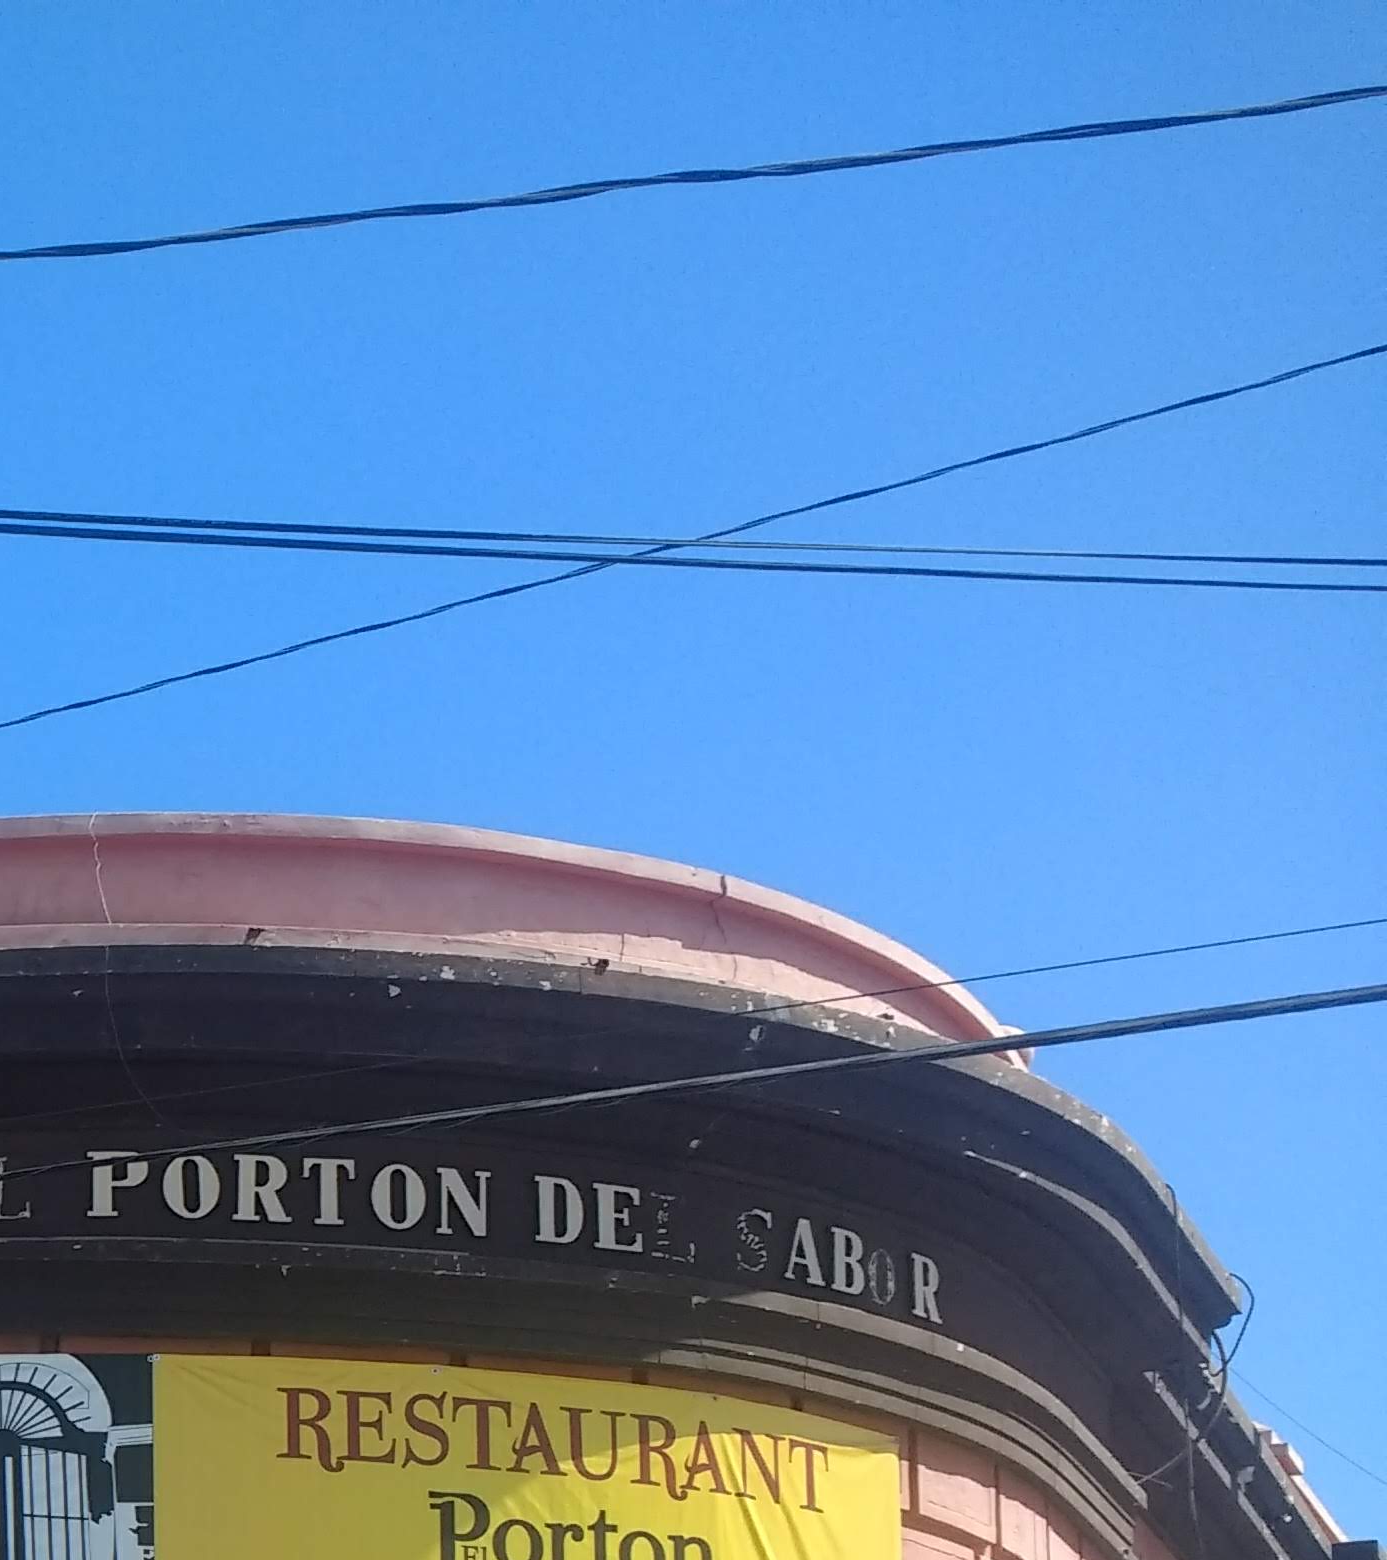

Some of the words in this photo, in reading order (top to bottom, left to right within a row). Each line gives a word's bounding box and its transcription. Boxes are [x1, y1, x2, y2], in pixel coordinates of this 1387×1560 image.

[85, 1151, 494, 1238] PORTON
[736, 1207, 945, 1326] SABOR
[276, 1386, 830, 1515] RESTAURANT
